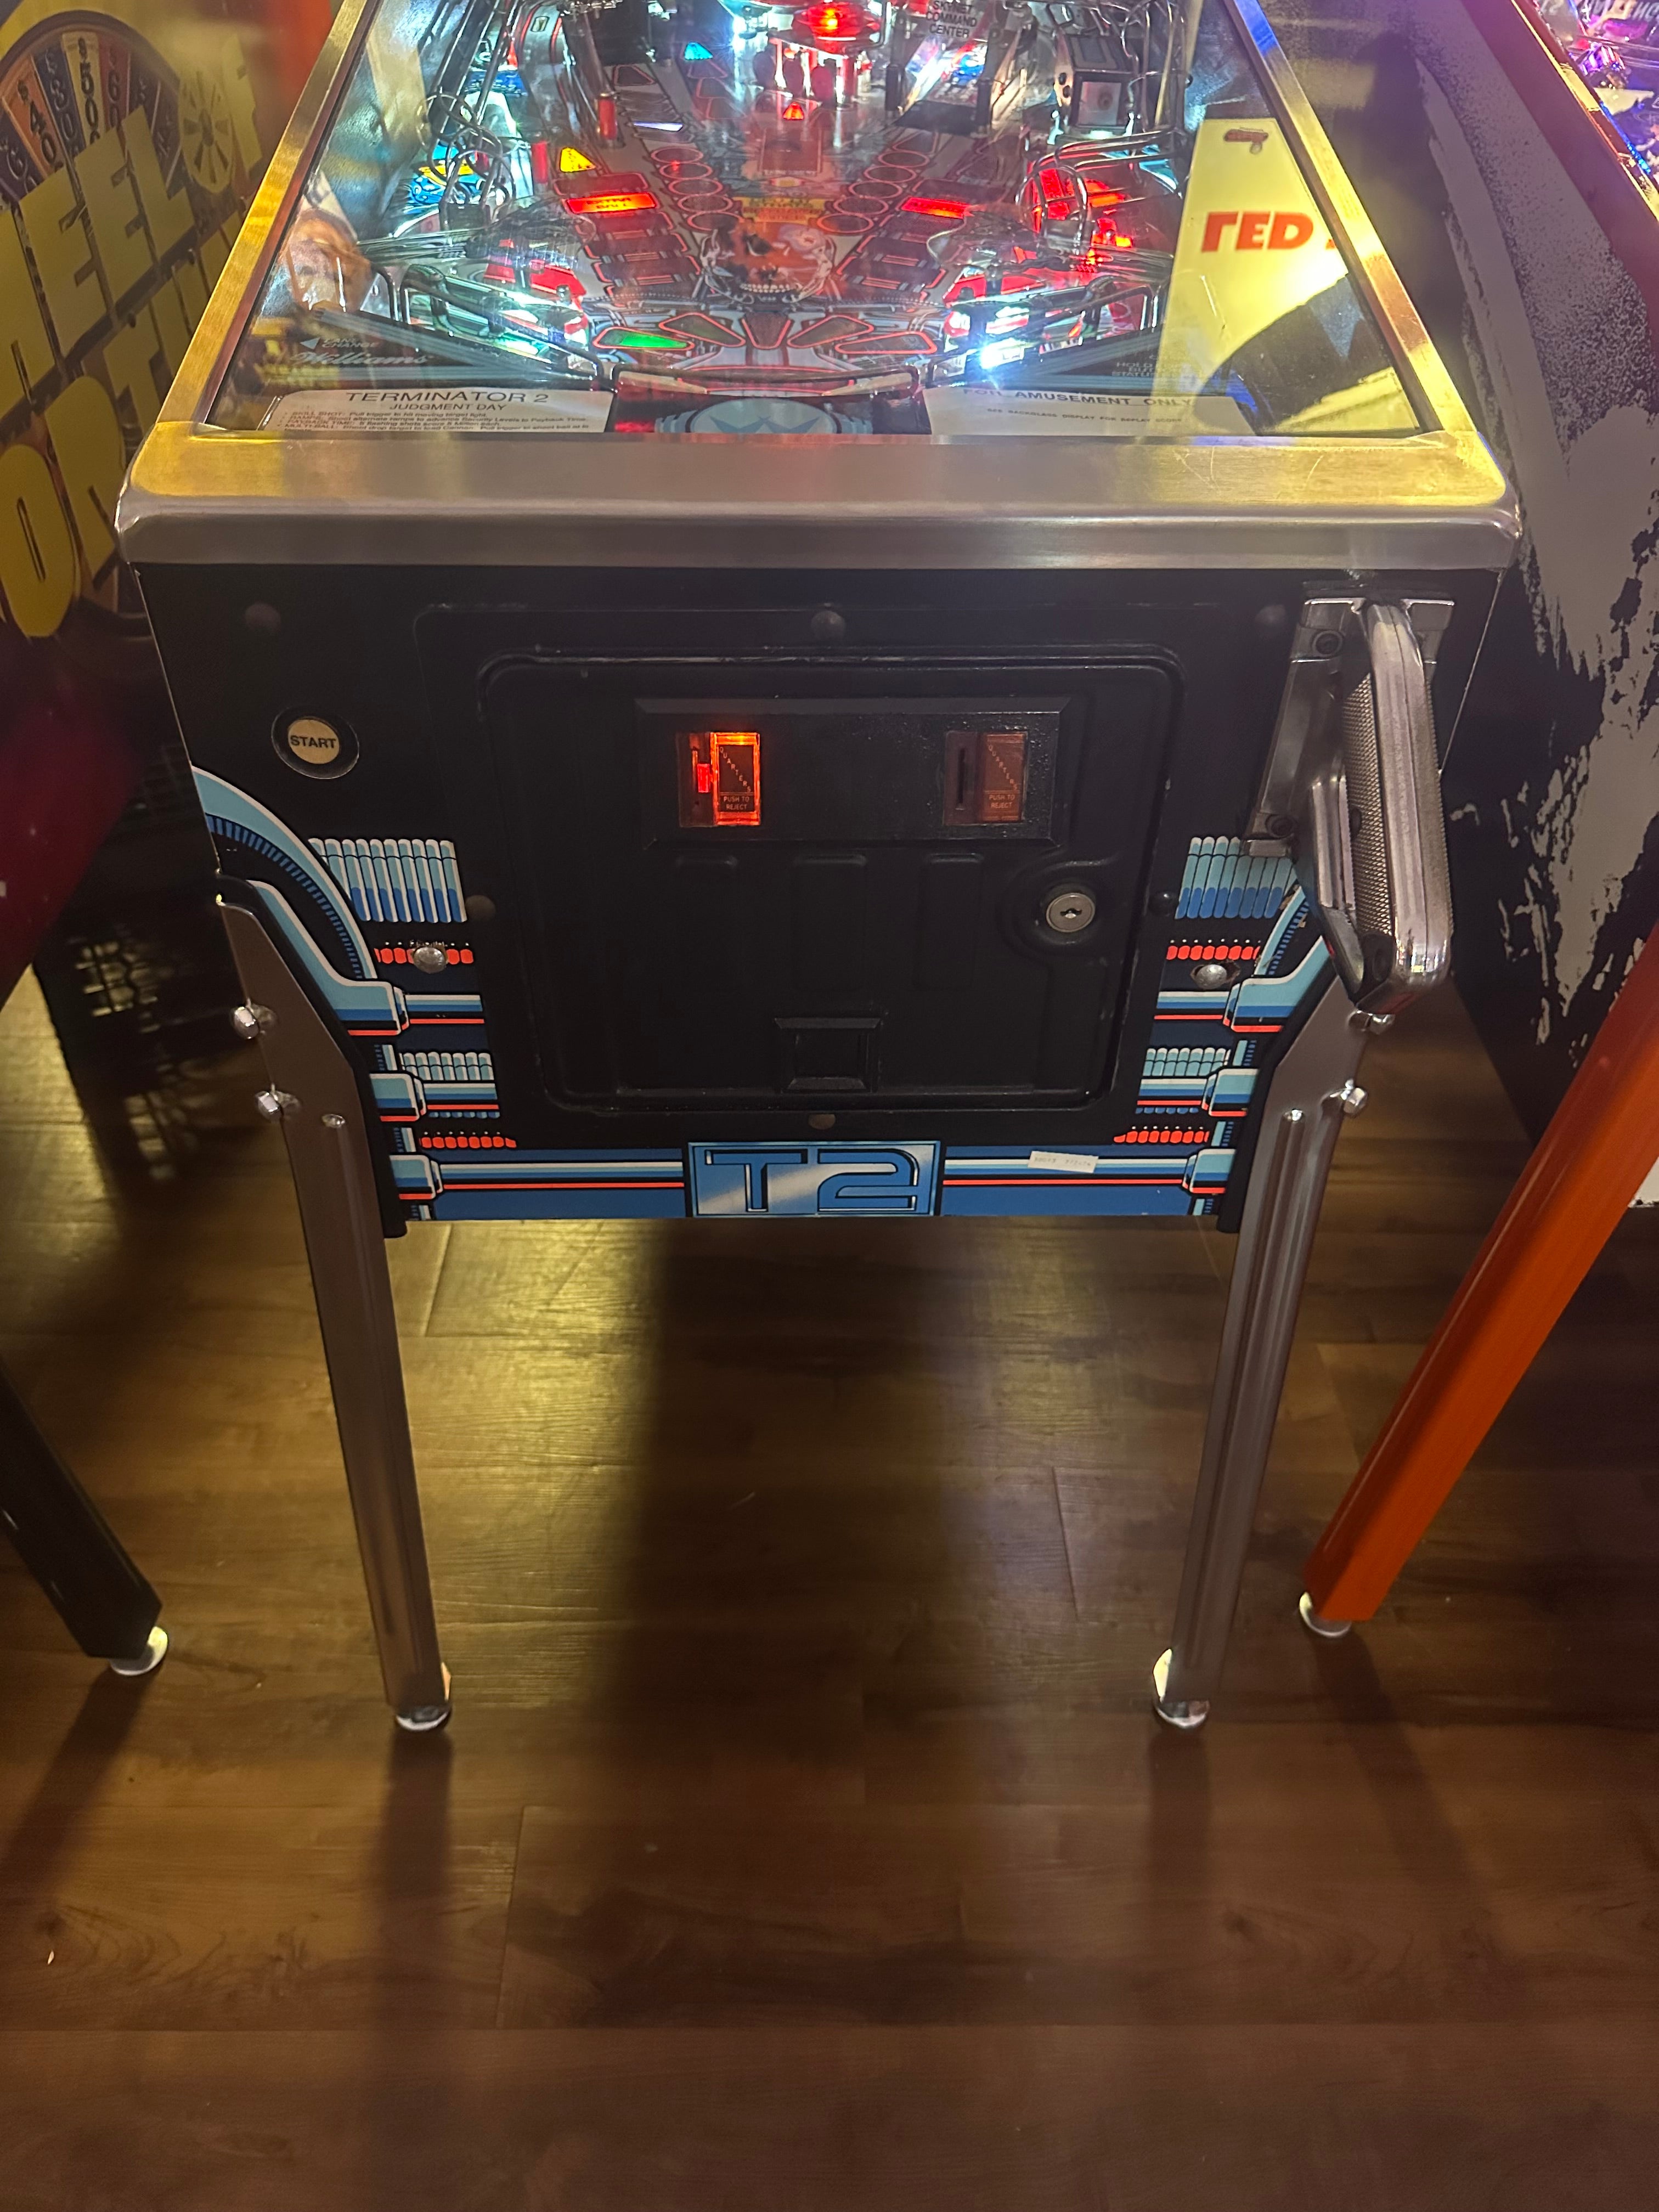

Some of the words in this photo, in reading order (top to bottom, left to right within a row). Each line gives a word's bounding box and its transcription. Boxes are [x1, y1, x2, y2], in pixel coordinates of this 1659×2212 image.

[926, 11, 977, 27] COMMAND
[930, 24, 969, 38] CENTER
[294, 352, 428, 365] Williams
[346, 392, 526, 403] TERMINATOR
[533, 394, 549, 403] 2
[1015, 391, 1131, 405] AMUSEMENT
[1144, 398, 1192, 406] ONLY
[290, 735, 336, 748] START
[719, 747, 751, 792] QUARTERS
[988, 745, 1018, 790] QUARTERS
[704, 1148, 919, 1212] T2
